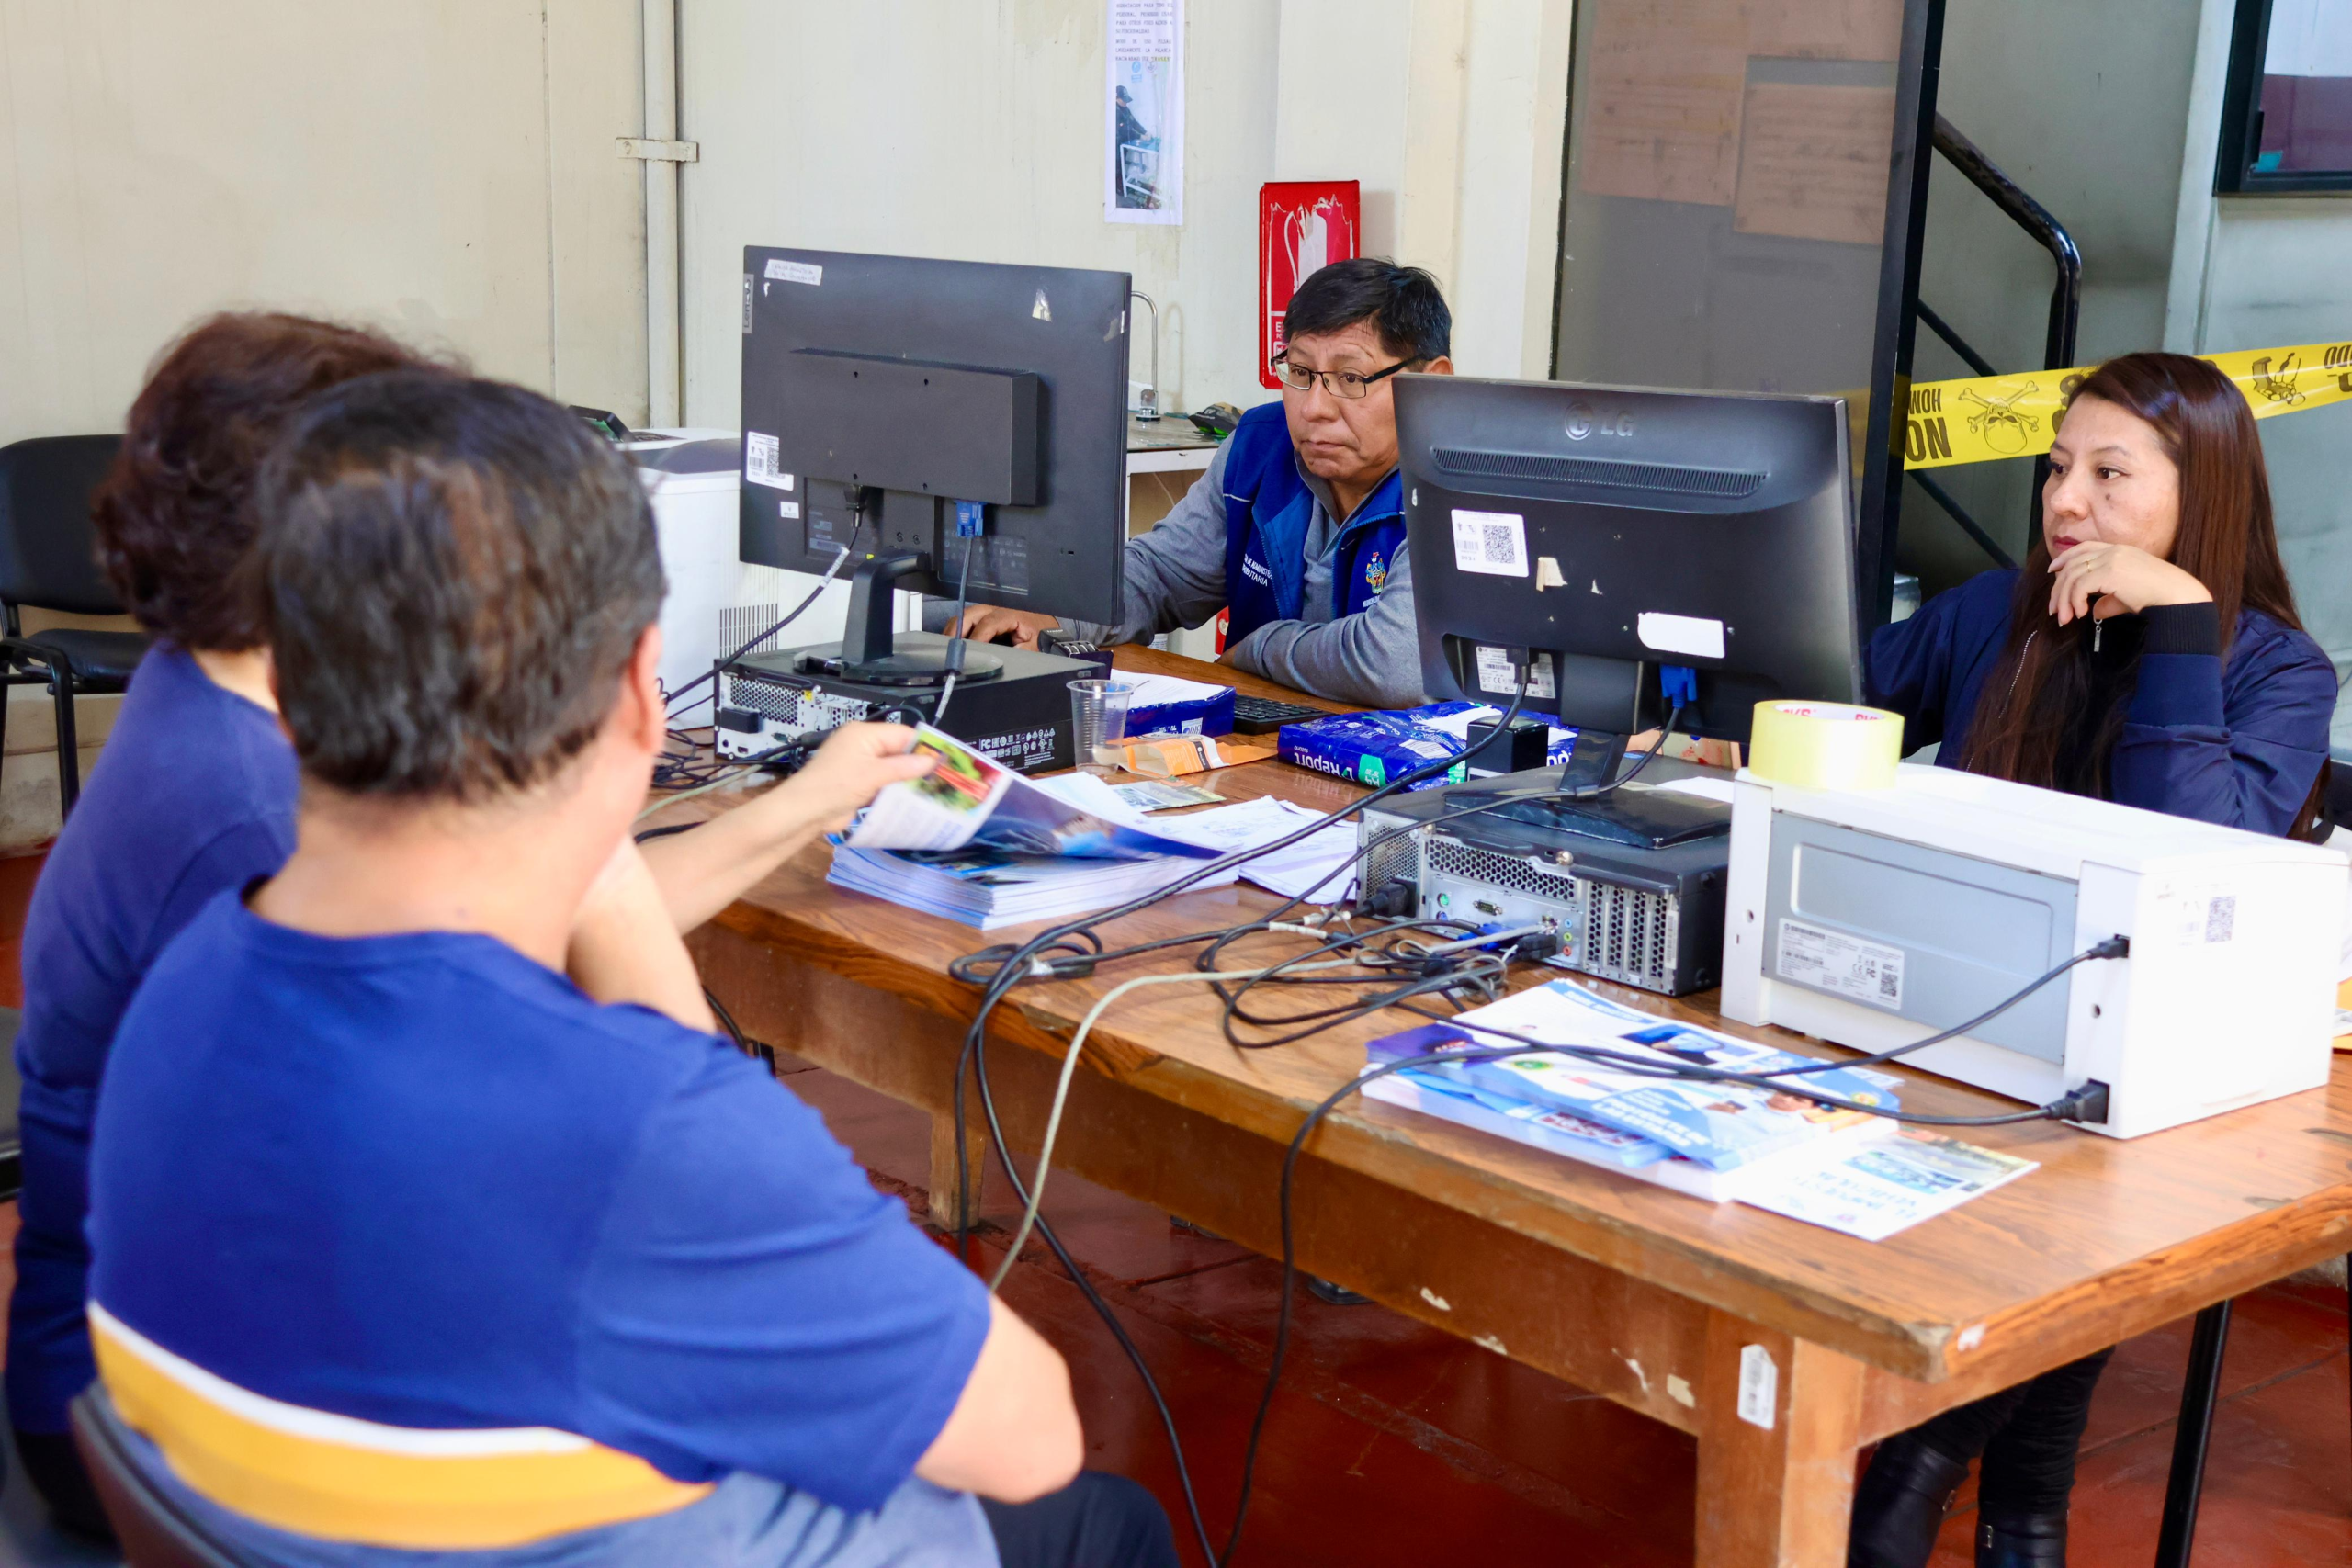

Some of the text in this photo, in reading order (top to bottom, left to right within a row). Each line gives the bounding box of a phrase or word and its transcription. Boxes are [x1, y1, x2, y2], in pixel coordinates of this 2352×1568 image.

[2324, 345, 2352, 369] DO
[1600, 408, 1634, 437] LG
[1905, 417, 1952, 462] NO
[1294, 751, 1340, 777] Report
